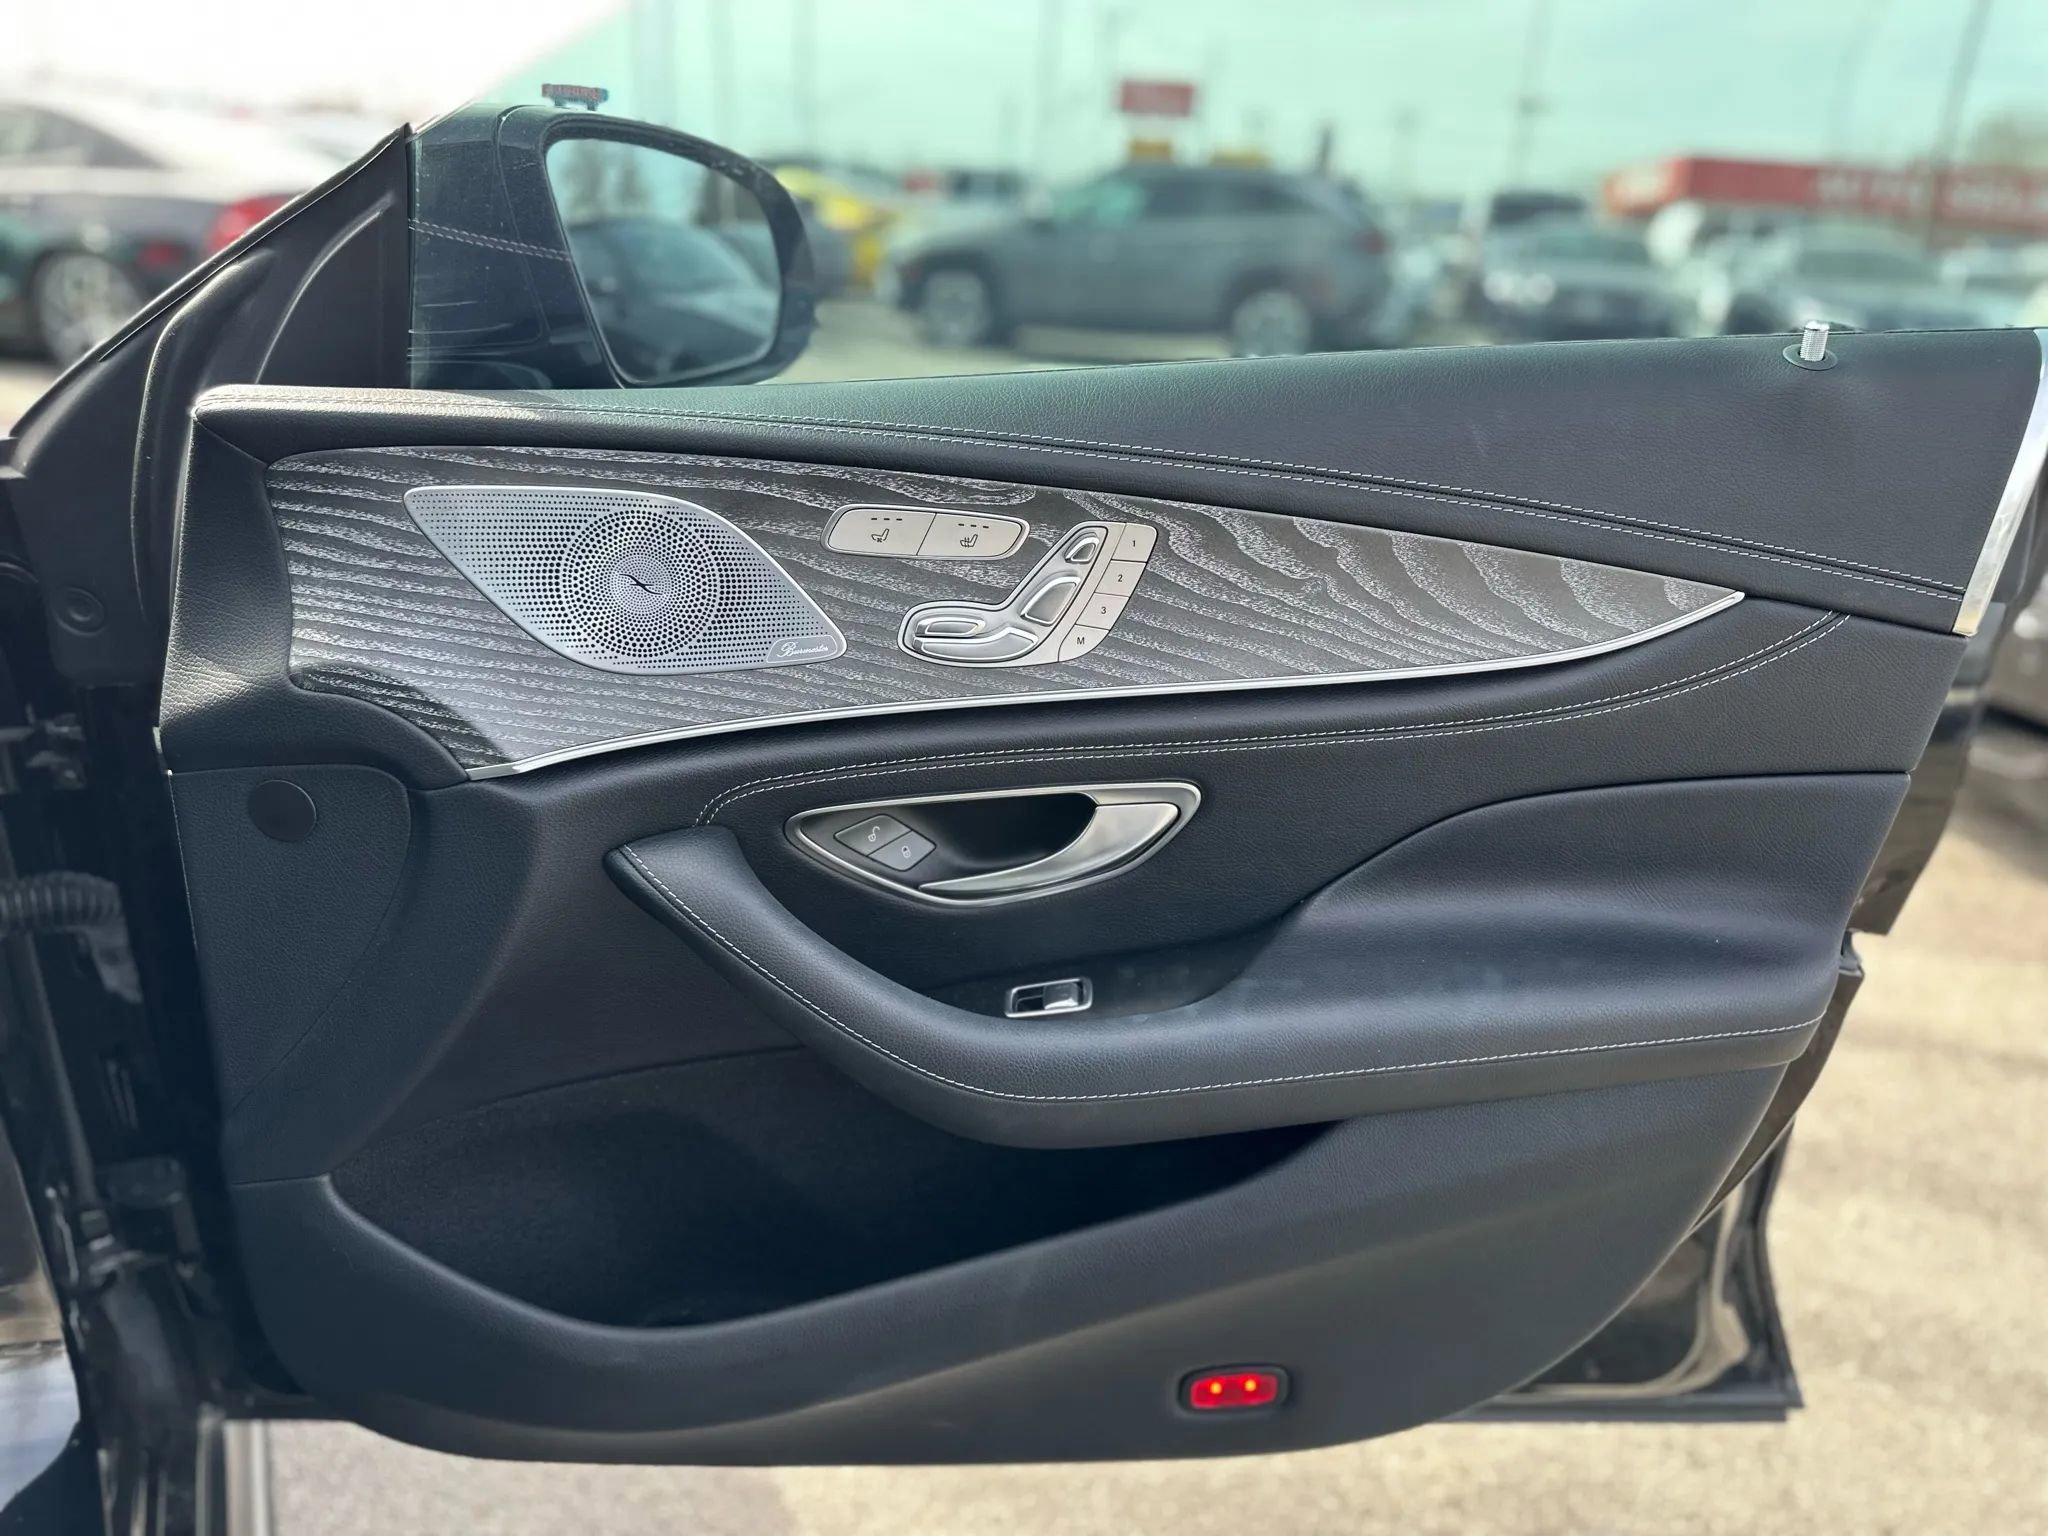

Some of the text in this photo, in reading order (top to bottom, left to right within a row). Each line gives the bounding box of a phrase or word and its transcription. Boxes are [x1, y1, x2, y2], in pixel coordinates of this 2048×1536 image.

[1131, 540, 1137, 548] 1
[1117, 574, 1123, 582] 2
[1100, 607, 1107, 615] 3
[1076, 637, 1085, 645] M
